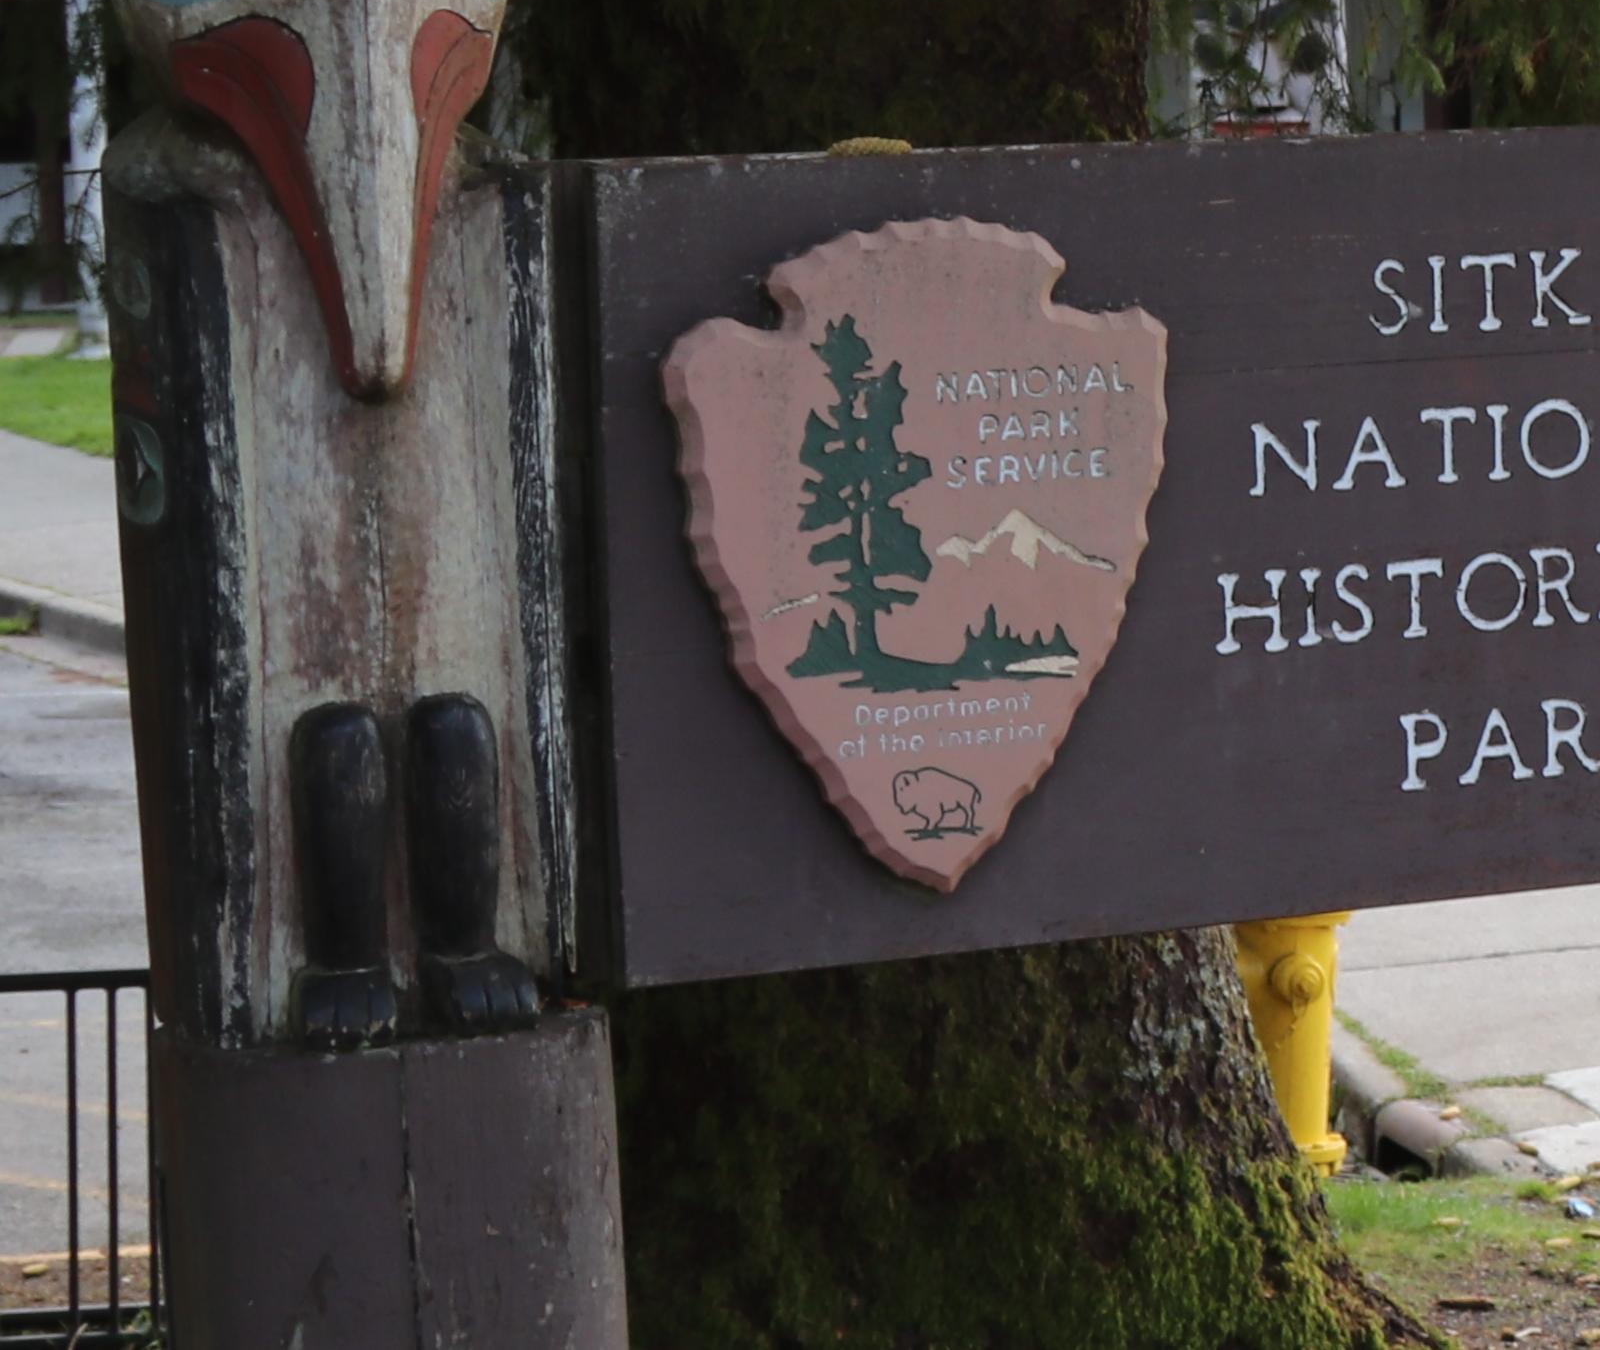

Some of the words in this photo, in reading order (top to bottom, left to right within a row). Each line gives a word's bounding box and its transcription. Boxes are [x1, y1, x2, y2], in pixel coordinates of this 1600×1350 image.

[936, 361, 1135, 402] NATIONAL
[979, 408, 1079, 443] PARK
[947, 449, 1110, 488] SERVICE
[855, 693, 1031, 727] Department
[839, 735, 866, 758] of
[880, 731, 925, 753] the
